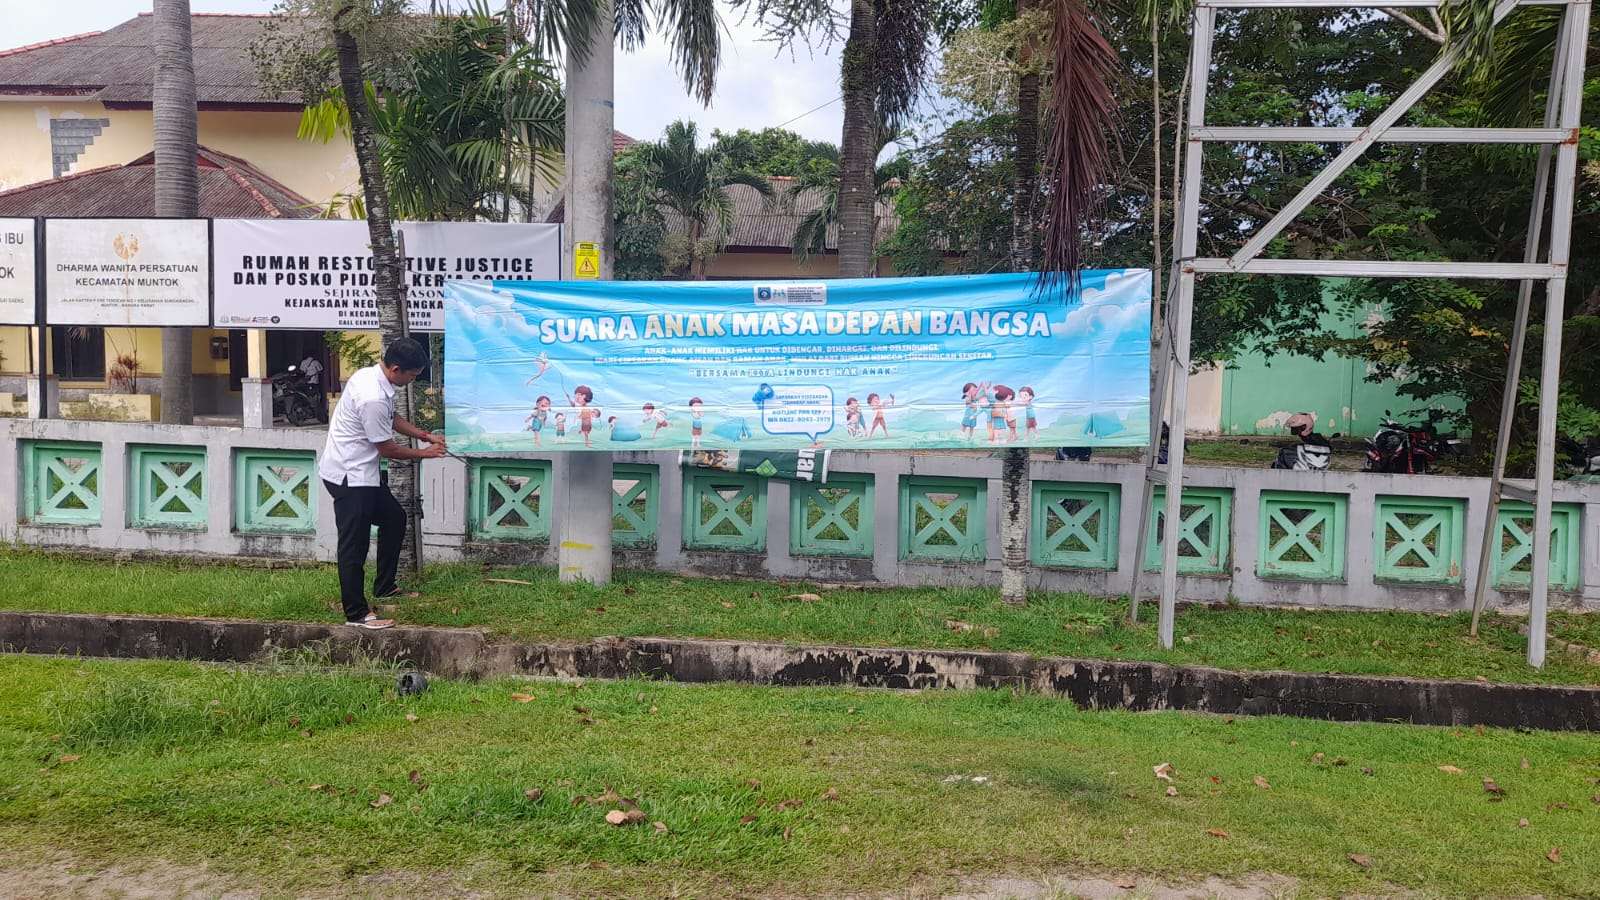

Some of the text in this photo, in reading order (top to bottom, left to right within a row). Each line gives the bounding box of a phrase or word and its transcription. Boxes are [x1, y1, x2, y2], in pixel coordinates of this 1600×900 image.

[4, 232, 24, 245] IBU
[56, 263, 199, 273] DHARMA WANITA PERSATUAN
[242, 255, 310, 270] RUMAH
[456, 257, 533, 273] JUSTICE
[75, 277, 179, 287] KECAMATAN MUNTOK
[233, 272, 267, 285] DAN
[275, 272, 332, 286] POSKO
[284, 298, 348, 308] KEJAKSAAN
[539, 310, 1052, 344] SUARA ANAK MASA DEPAN BANGSA
[777, 367, 831, 377] LINDUNGI
